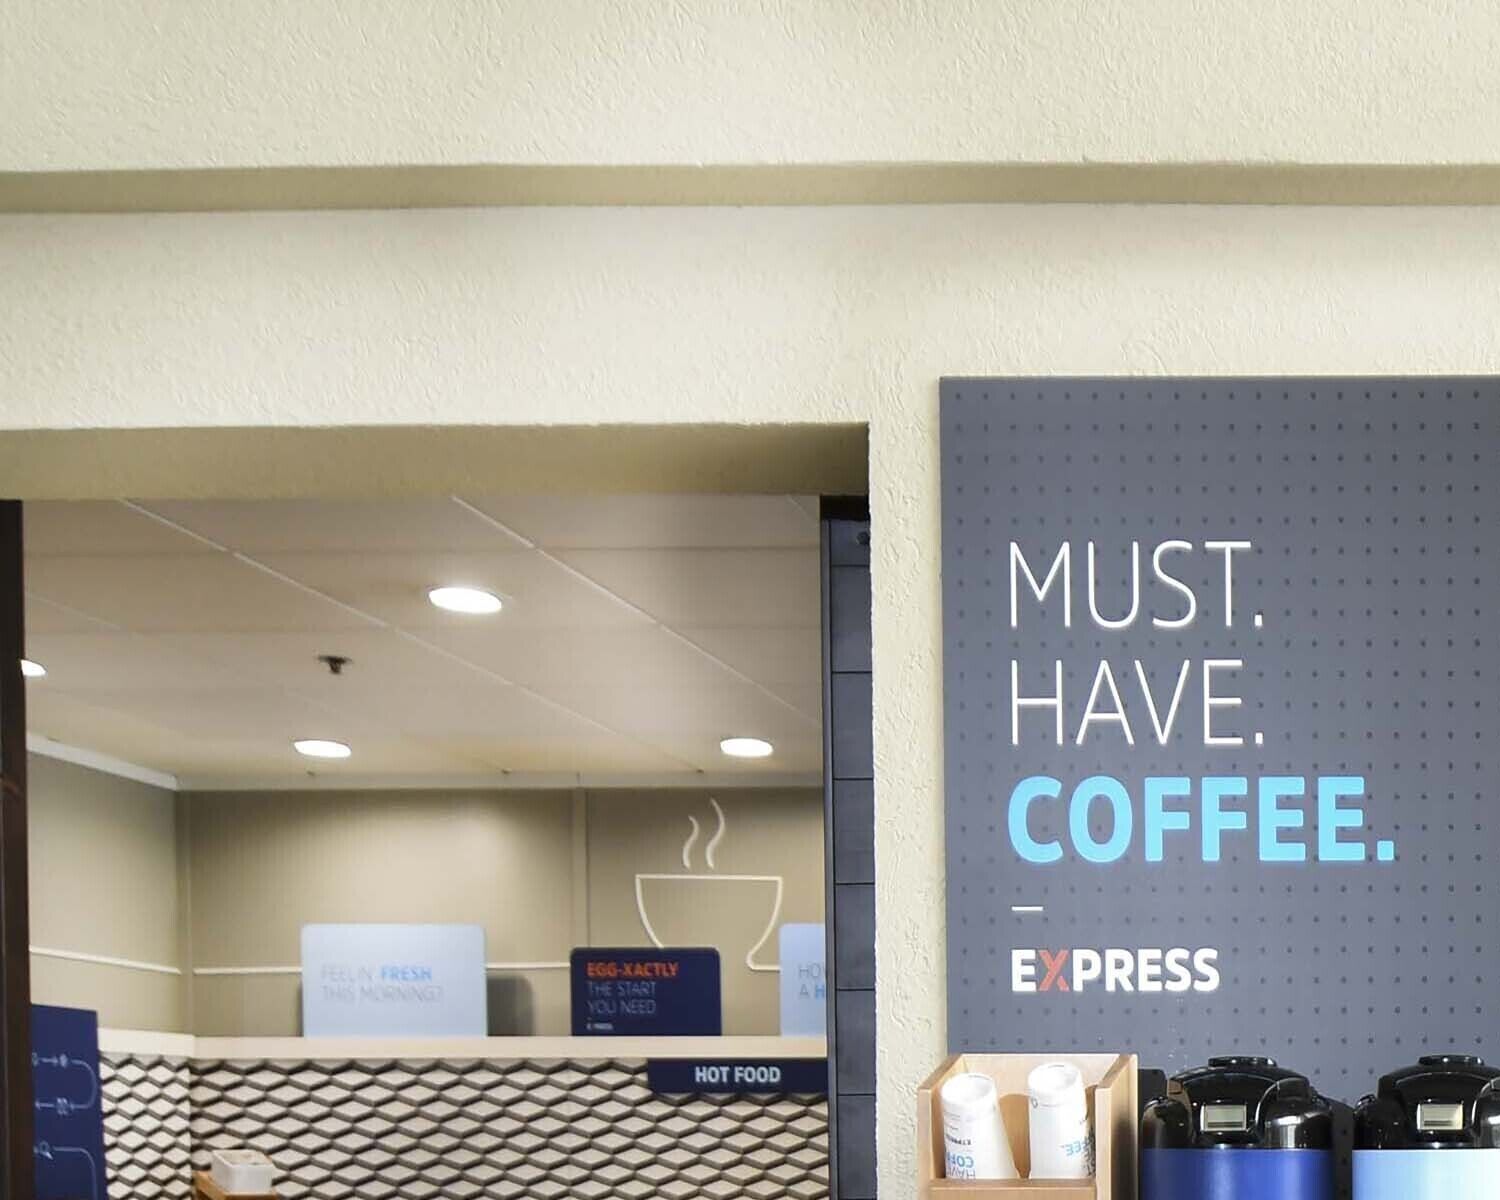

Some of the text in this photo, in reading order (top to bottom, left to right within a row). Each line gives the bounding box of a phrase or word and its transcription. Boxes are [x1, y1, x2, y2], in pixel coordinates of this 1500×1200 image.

[1010, 540, 1263, 628] MUST.
[1011, 659, 1264, 745] HAVE.
[1007, 776, 1394, 863] COFFEE.
[380, 965, 432, 982] FRESH
[586, 962, 679, 978] EGG-XACTLY
[1011, 949, 1220, 992] EXPRESS
[588, 981, 656, 997] THE START
[588, 1000, 656, 1015] YOU NEED
[695, 1066, 781, 1083] HOT FOOD
